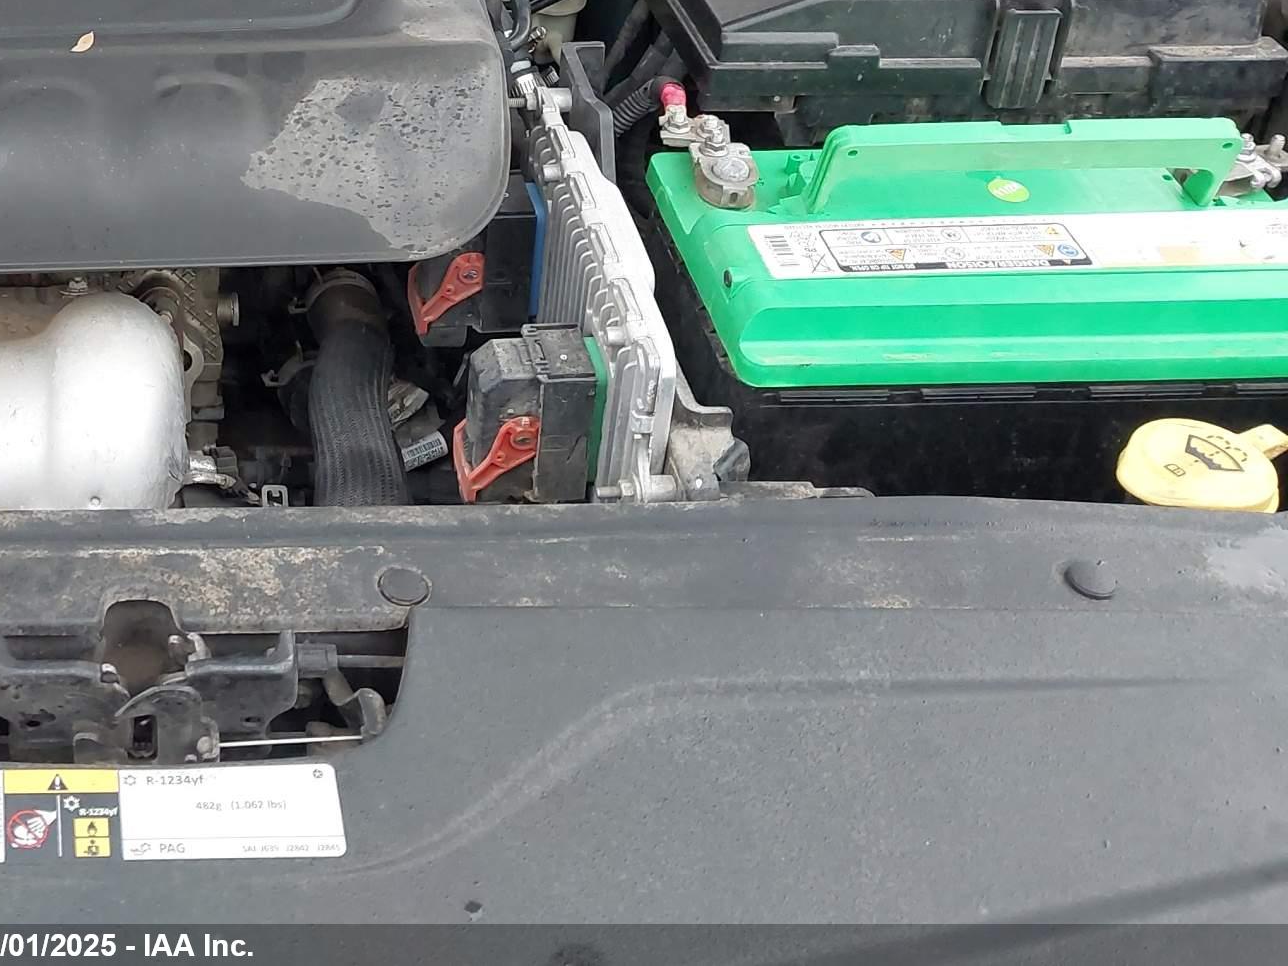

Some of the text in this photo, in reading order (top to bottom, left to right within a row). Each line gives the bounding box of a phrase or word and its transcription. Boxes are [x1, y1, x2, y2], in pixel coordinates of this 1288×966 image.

[146, 774, 204, 786] R-1234yf
[195, 801, 222, 811] 482g
[267, 800, 287, 810] lbs)
[159, 843, 186, 854] PAG
